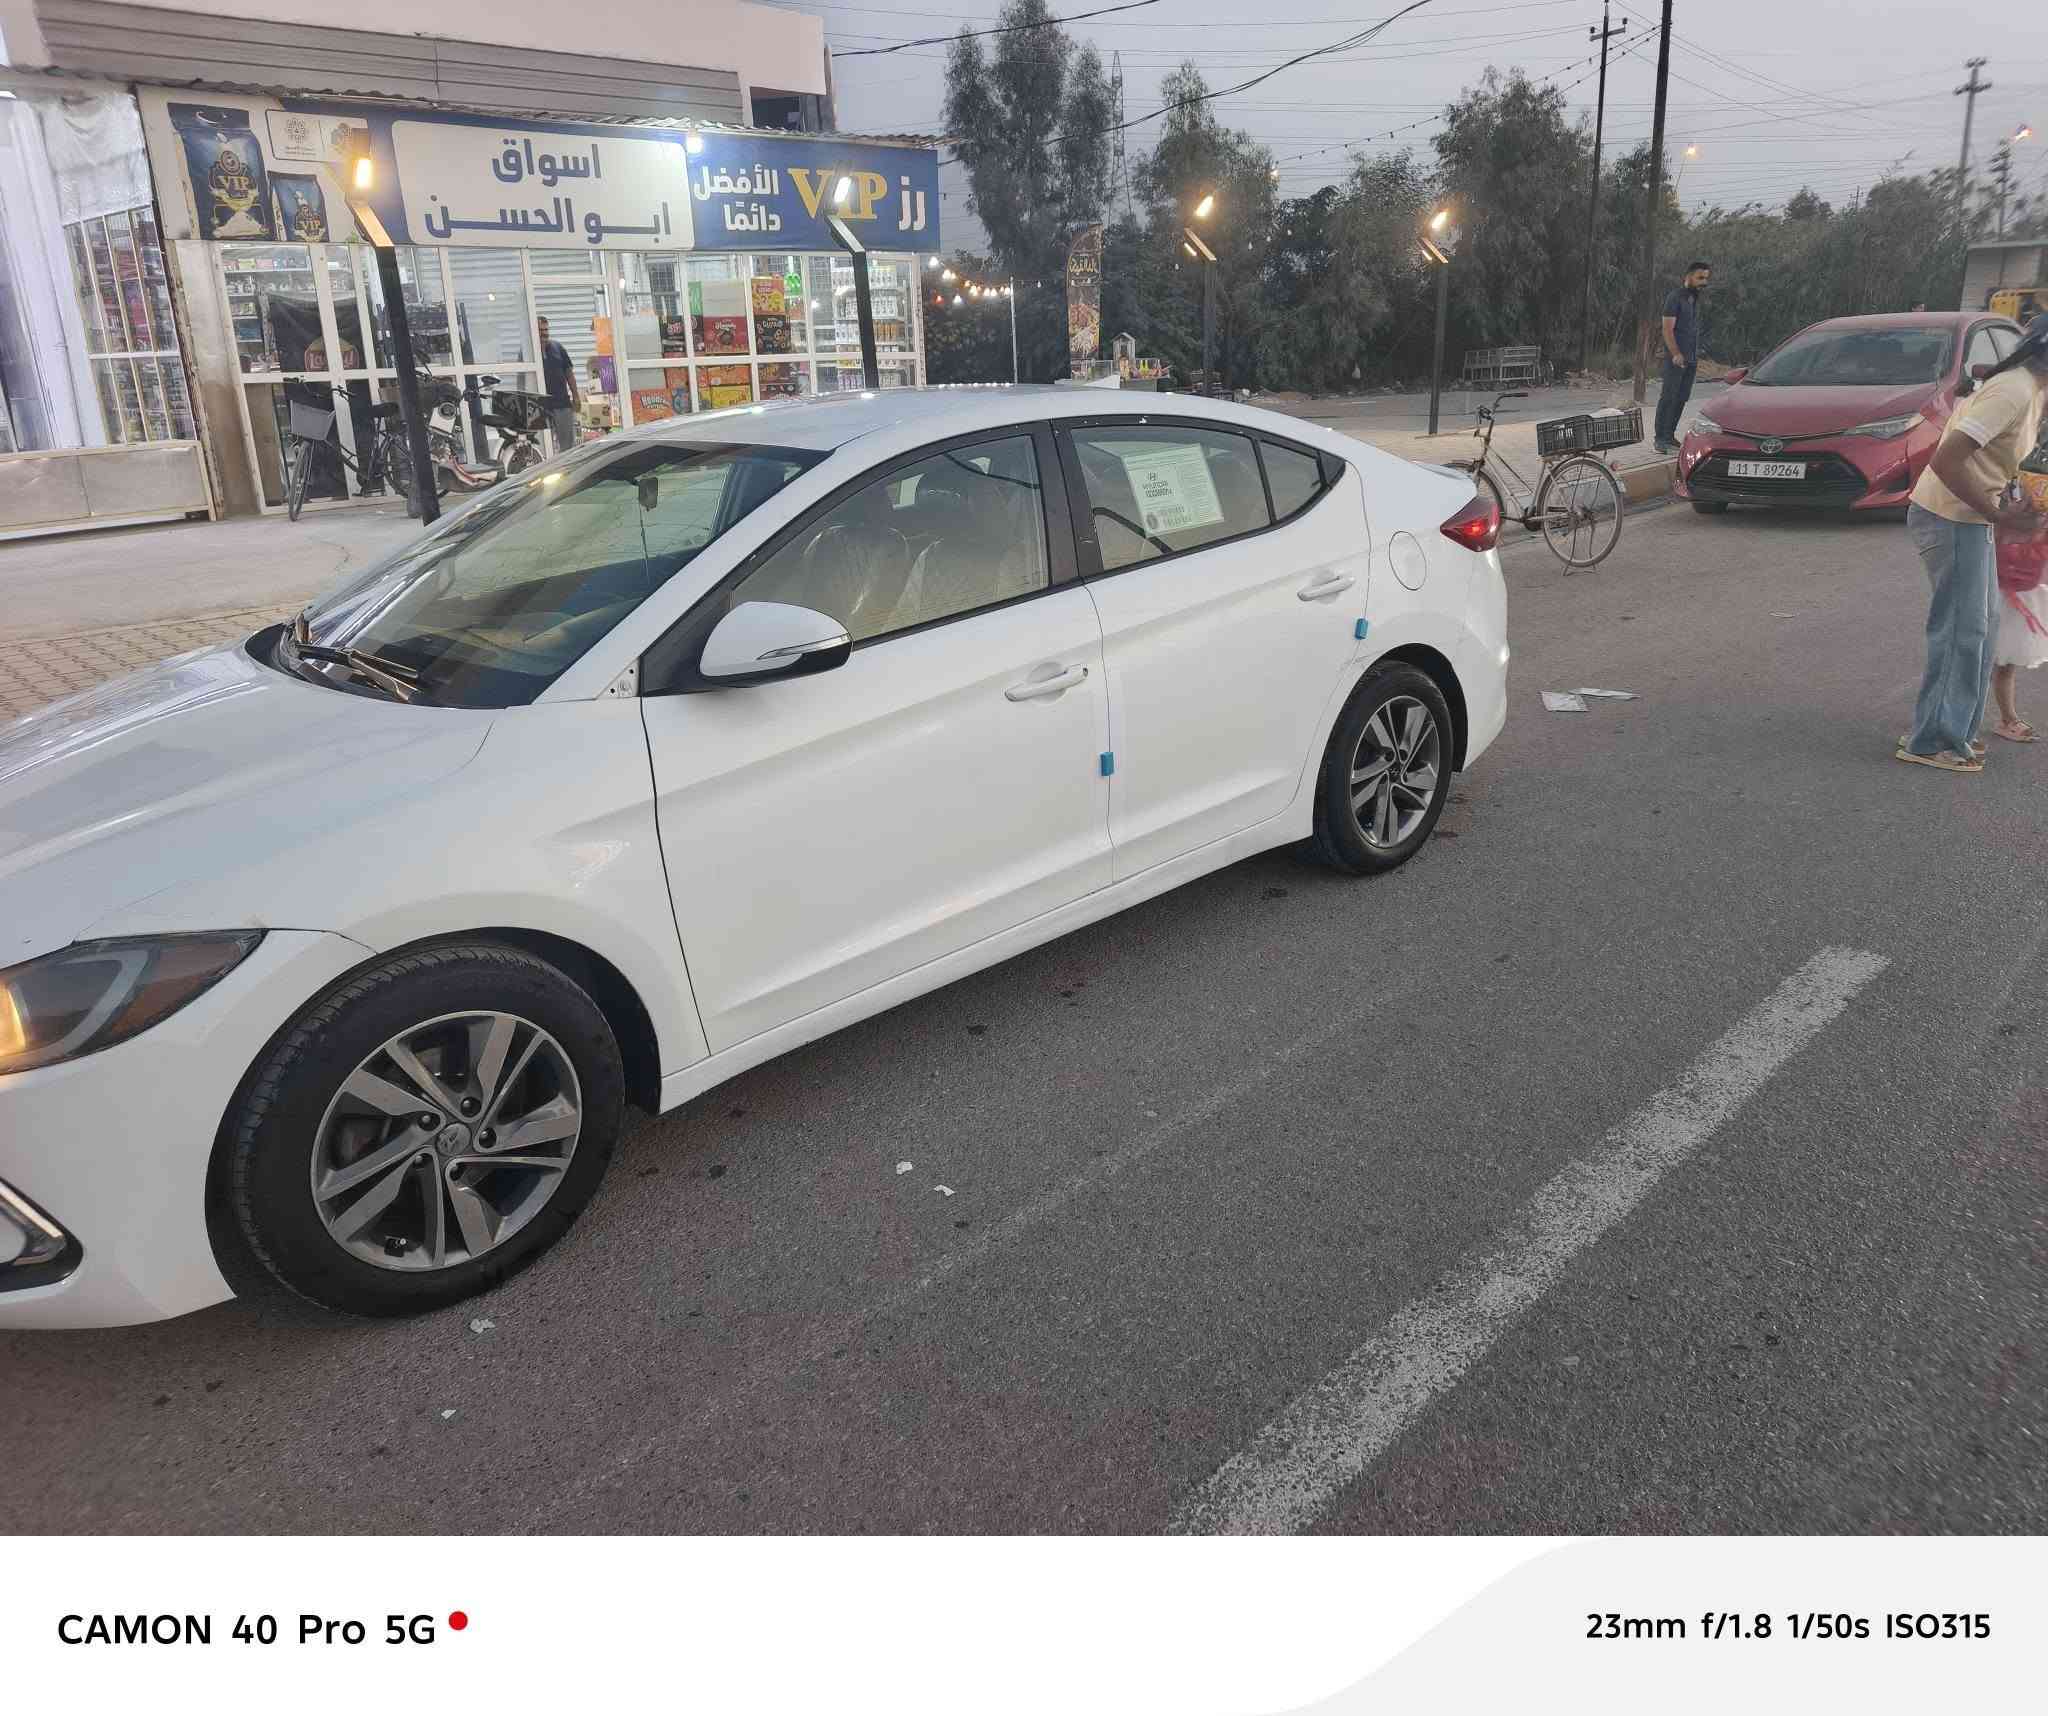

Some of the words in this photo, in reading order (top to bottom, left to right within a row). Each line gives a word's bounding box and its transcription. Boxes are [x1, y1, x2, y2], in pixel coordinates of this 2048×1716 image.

[492, 138, 602, 187] اسواق
[693, 163, 780, 201] الأفضل
[424, 194, 575, 239] الحسن
[584, 201, 672, 244] ابو
[898, 176, 927, 231] رز
[1736, 463, 1748, 475] 11
[1753, 464, 1760, 475] T
